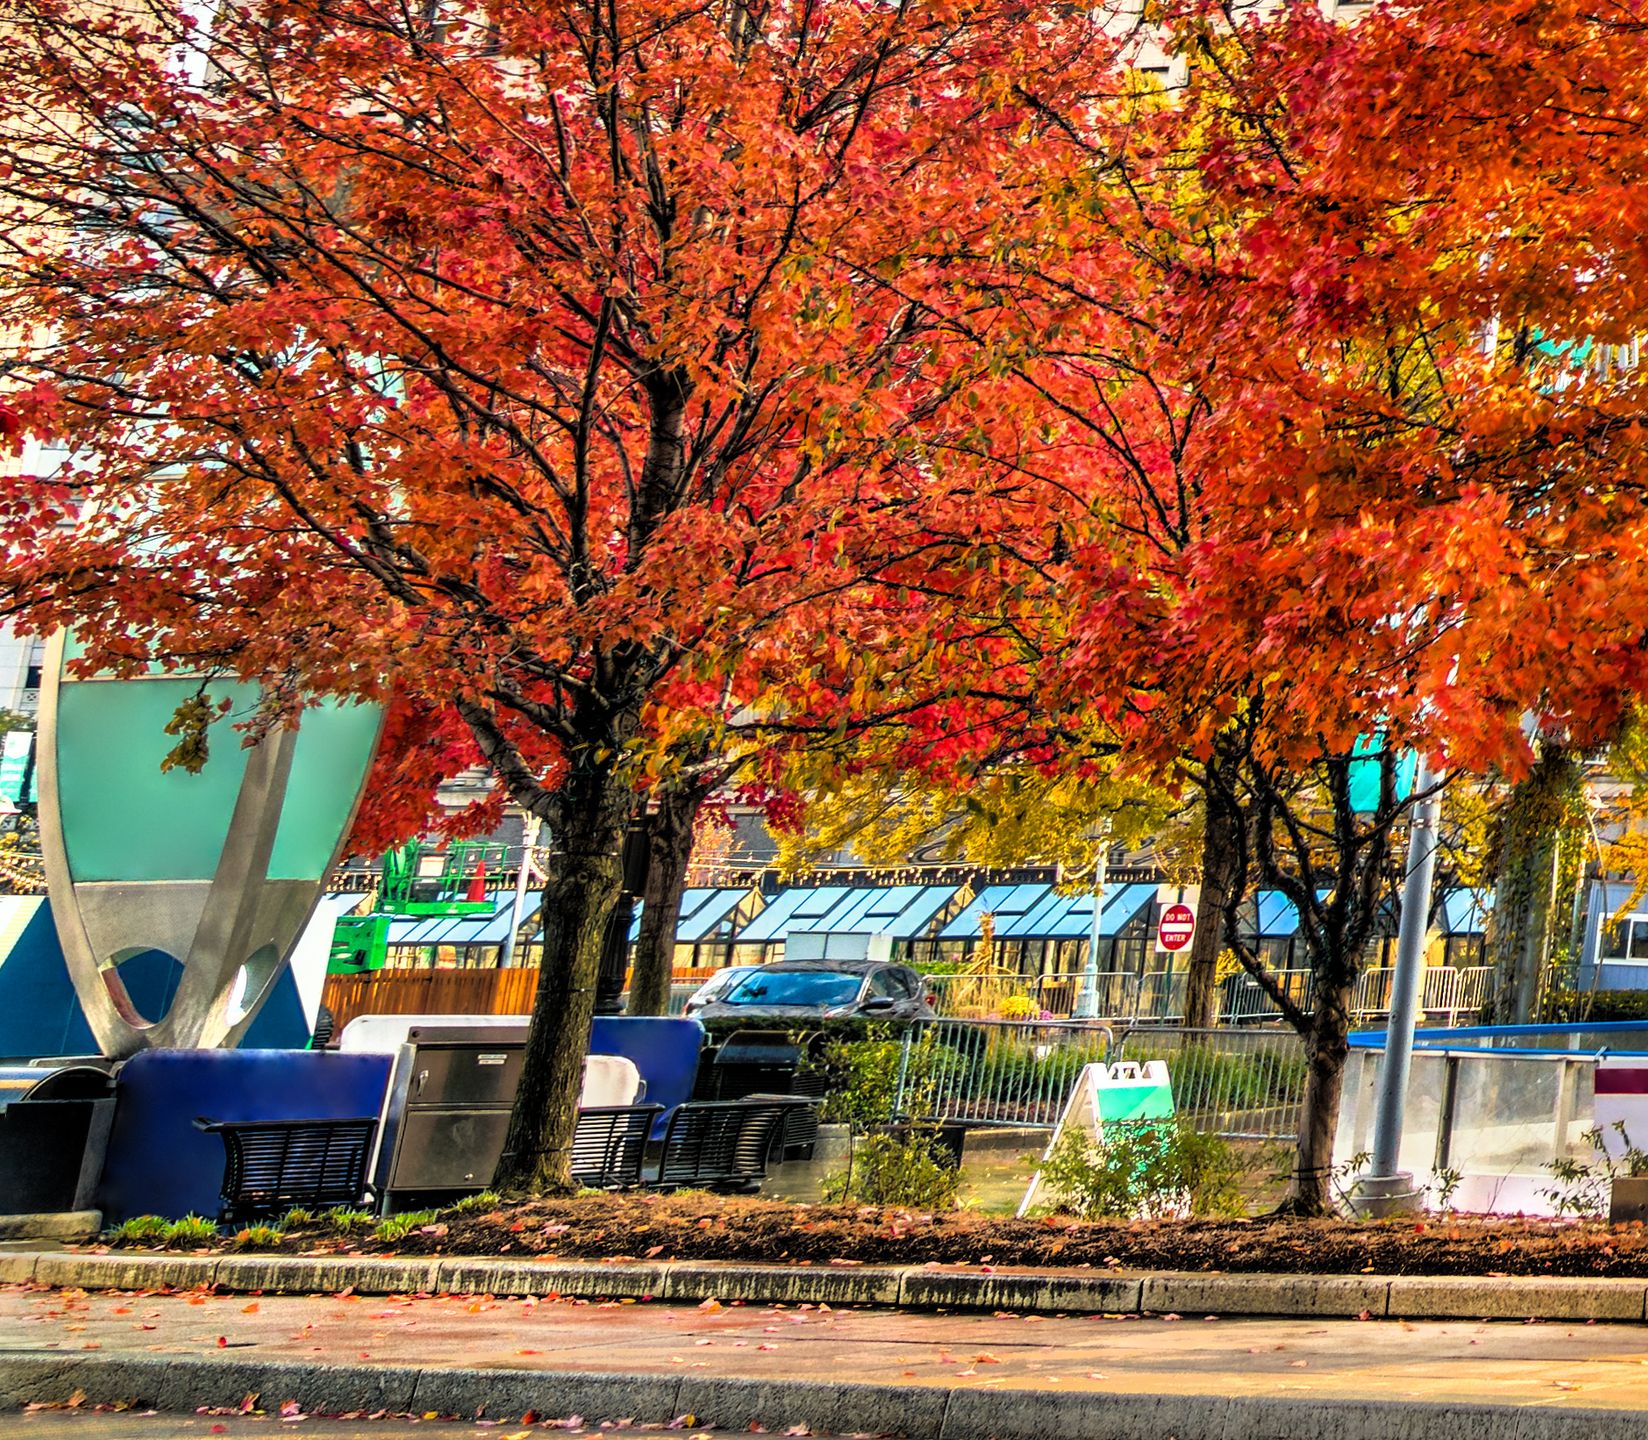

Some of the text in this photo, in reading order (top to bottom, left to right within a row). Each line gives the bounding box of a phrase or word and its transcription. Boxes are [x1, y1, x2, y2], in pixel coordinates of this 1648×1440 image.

[1165, 913, 1191, 922] DO NOT
[1165, 934, 1186, 942] ENTER
